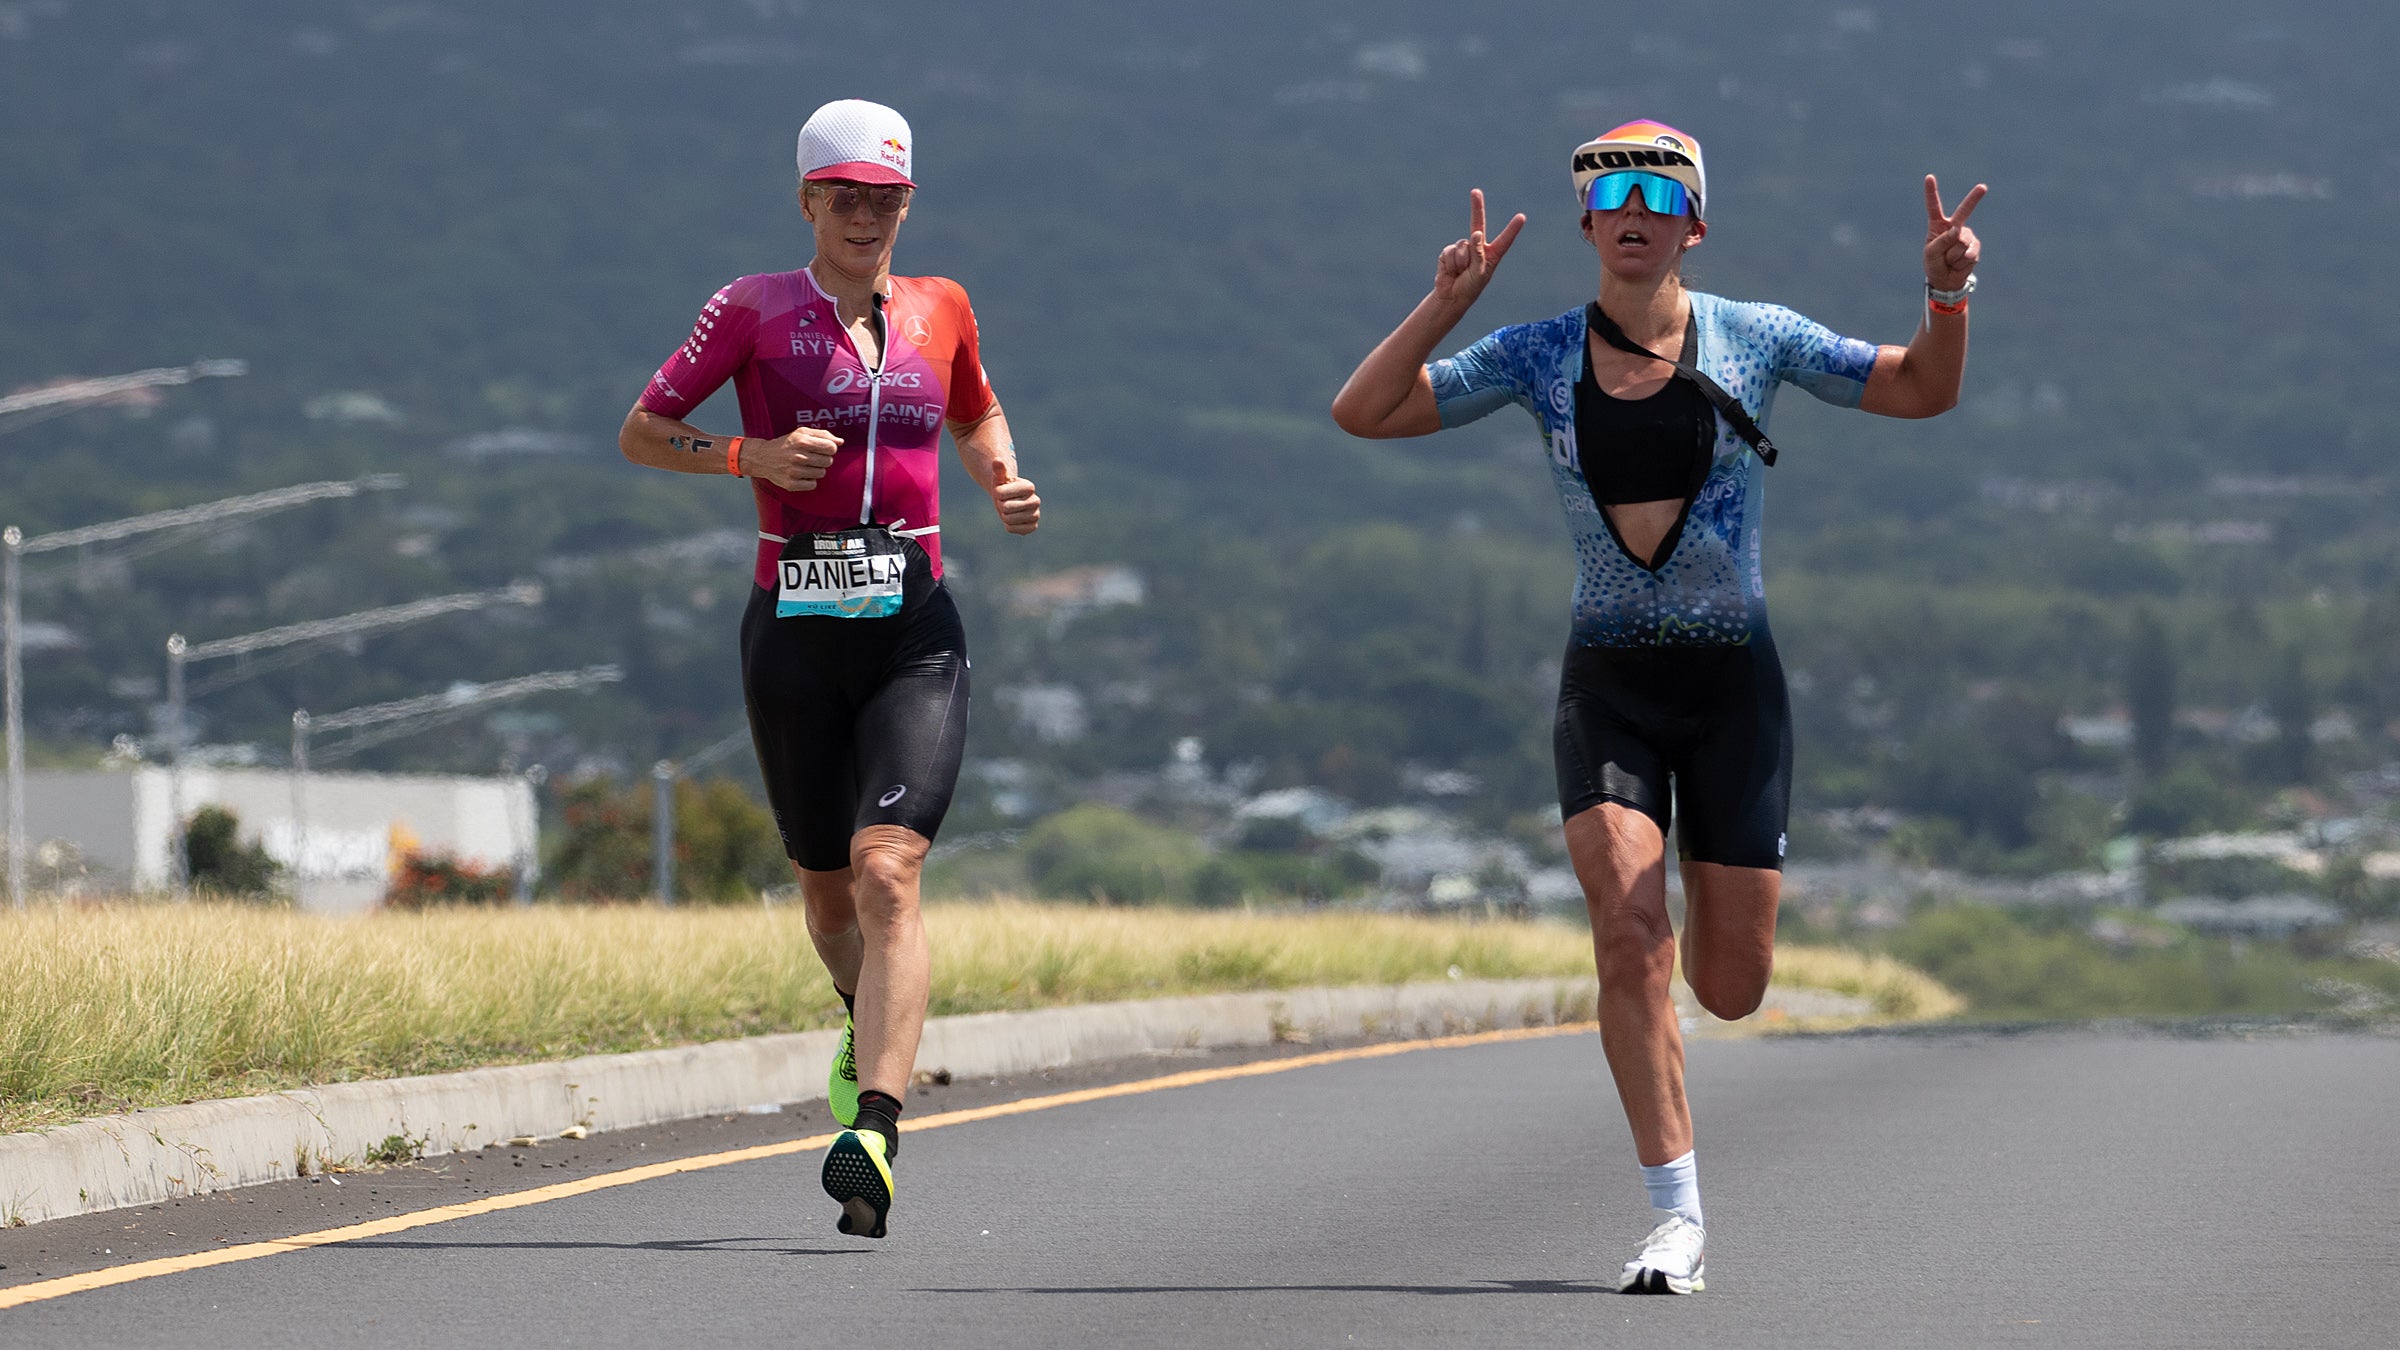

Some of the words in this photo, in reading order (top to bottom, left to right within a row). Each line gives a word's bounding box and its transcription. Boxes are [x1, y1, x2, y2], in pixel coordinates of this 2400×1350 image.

[881, 150, 895, 162] Red
[1573, 151, 1695, 173] KONA
[791, 339, 837, 356] RYF
[796, 403, 923, 423] BAHRAIN
[783, 557, 901, 590] DANIELA
